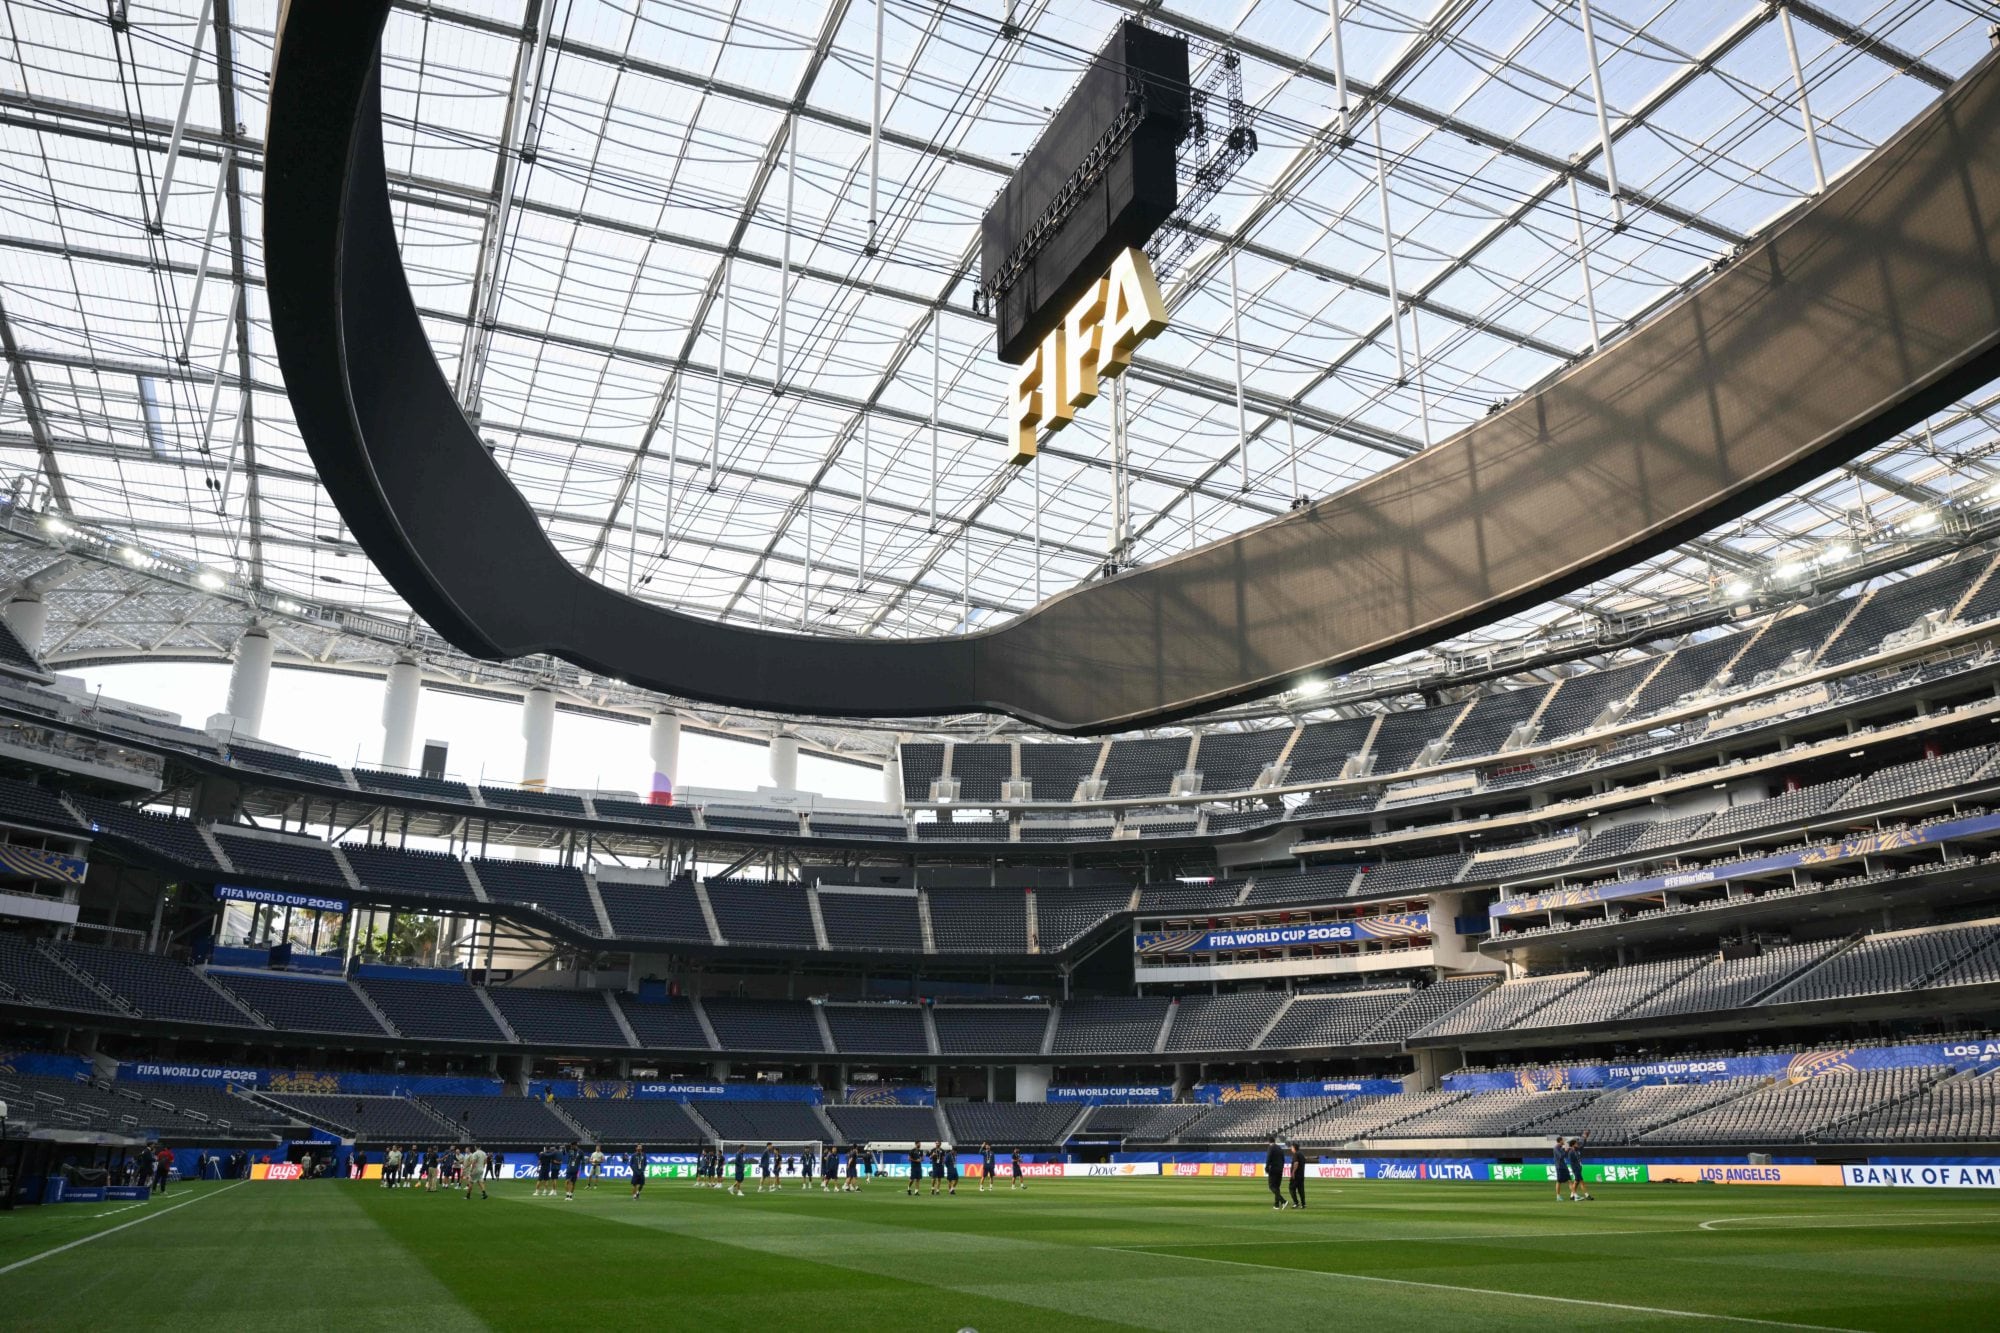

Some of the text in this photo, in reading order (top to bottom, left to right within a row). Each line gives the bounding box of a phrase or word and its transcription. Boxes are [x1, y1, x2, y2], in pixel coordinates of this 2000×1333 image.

[1008, 246, 1168, 466] FIFA
[221, 887, 343, 910] FIFA WORLD CUP 2026
[1210, 926, 1352, 947] FIFA WORLD CUP 2026
[1944, 1045, 1980, 1057] LOS
[137, 1065, 257, 1080] FIFA WORLD CUP 2026
[1609, 1061, 1726, 1078] FIFA WORLD CUP 2026
[668, 1085, 725, 1093] ANGELES
[1058, 1087, 1159, 1096] FIFA WORLD CUP 2026
[994, 1164, 1062, 1176] Mconald's
[1088, 1165, 1117, 1176] Dove
[1318, 1165, 1353, 1178] verizon
[1377, 1164, 1473, 1179] Michelob ULTRA
[1616, 1166, 1641, 1181] 蒙牛
[1700, 1168, 1781, 1181] LOS ANGELES
[1852, 1167, 2000, 1185] BANK OF AM
